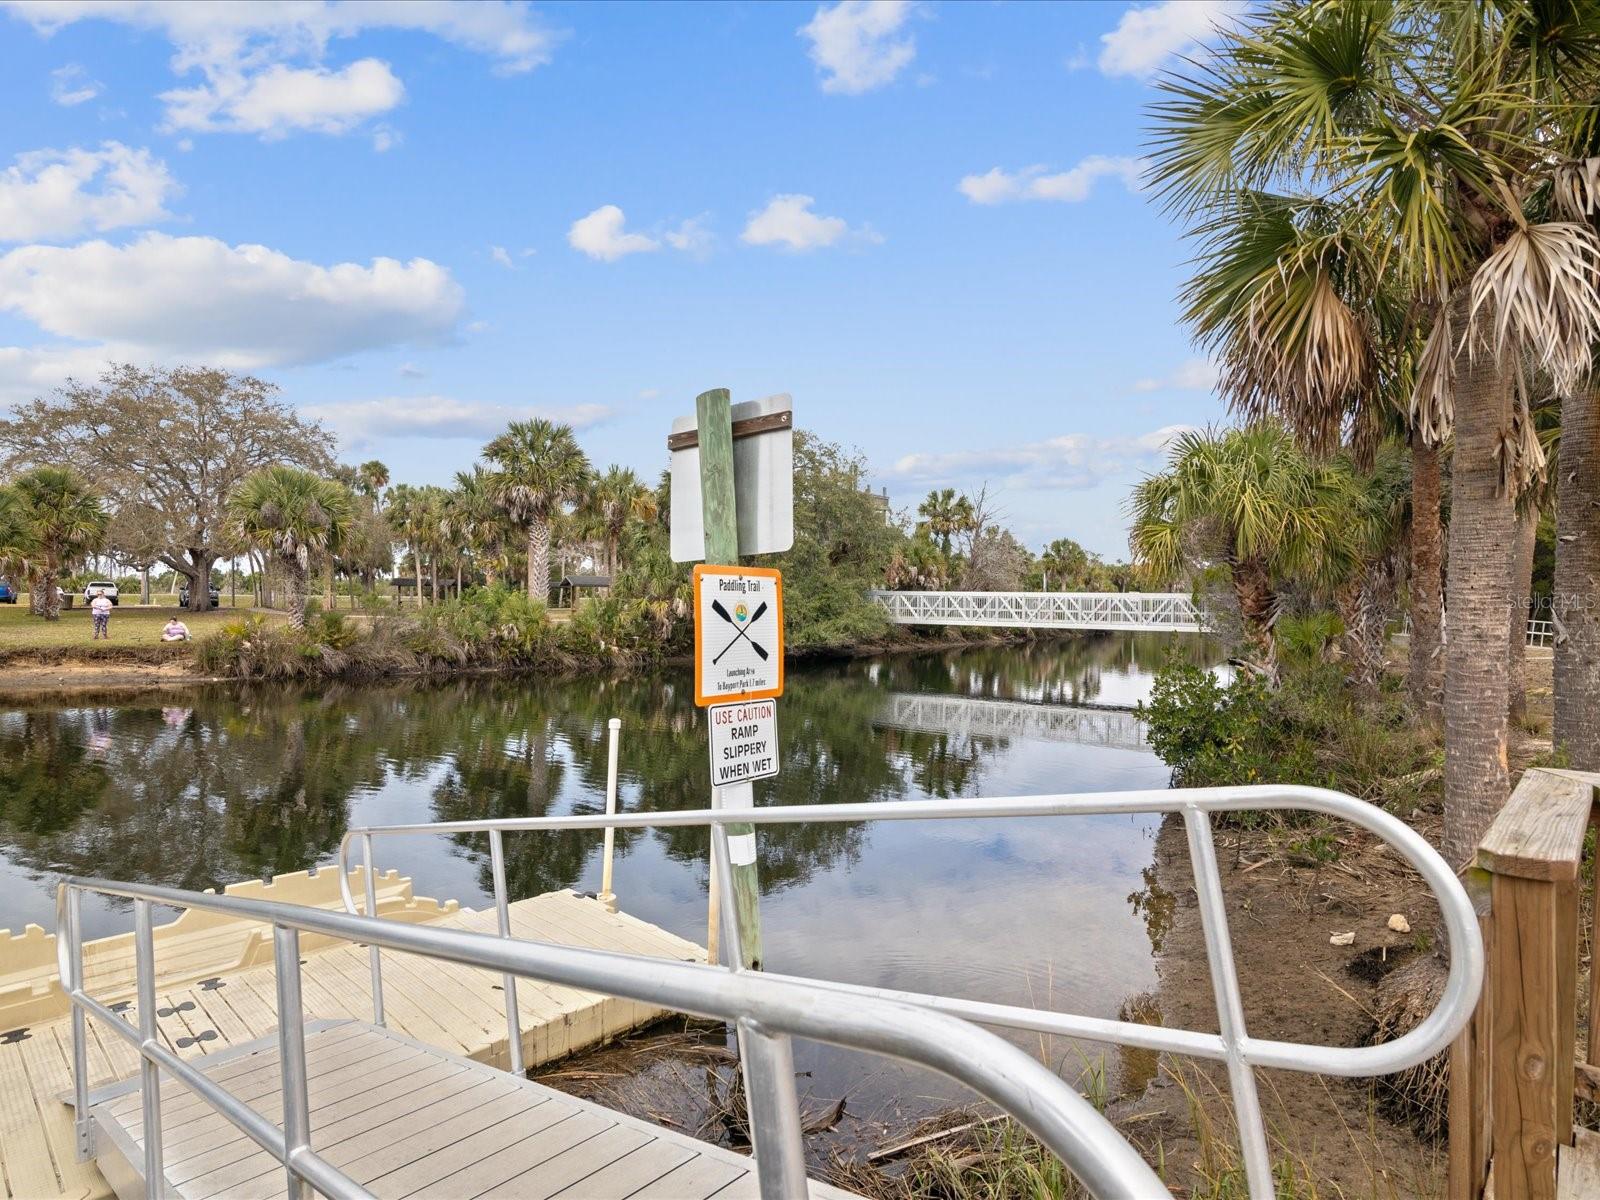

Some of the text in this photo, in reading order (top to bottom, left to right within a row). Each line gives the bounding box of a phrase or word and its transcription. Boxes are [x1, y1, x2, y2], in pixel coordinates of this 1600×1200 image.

[719, 579, 760, 594] Paddling Trail
[715, 705, 771, 725] USE CAUTION
[731, 724, 759, 741] RAMP
[723, 740, 767, 760] SLIPPERY
[719, 758, 771, 779] WHEN WET
